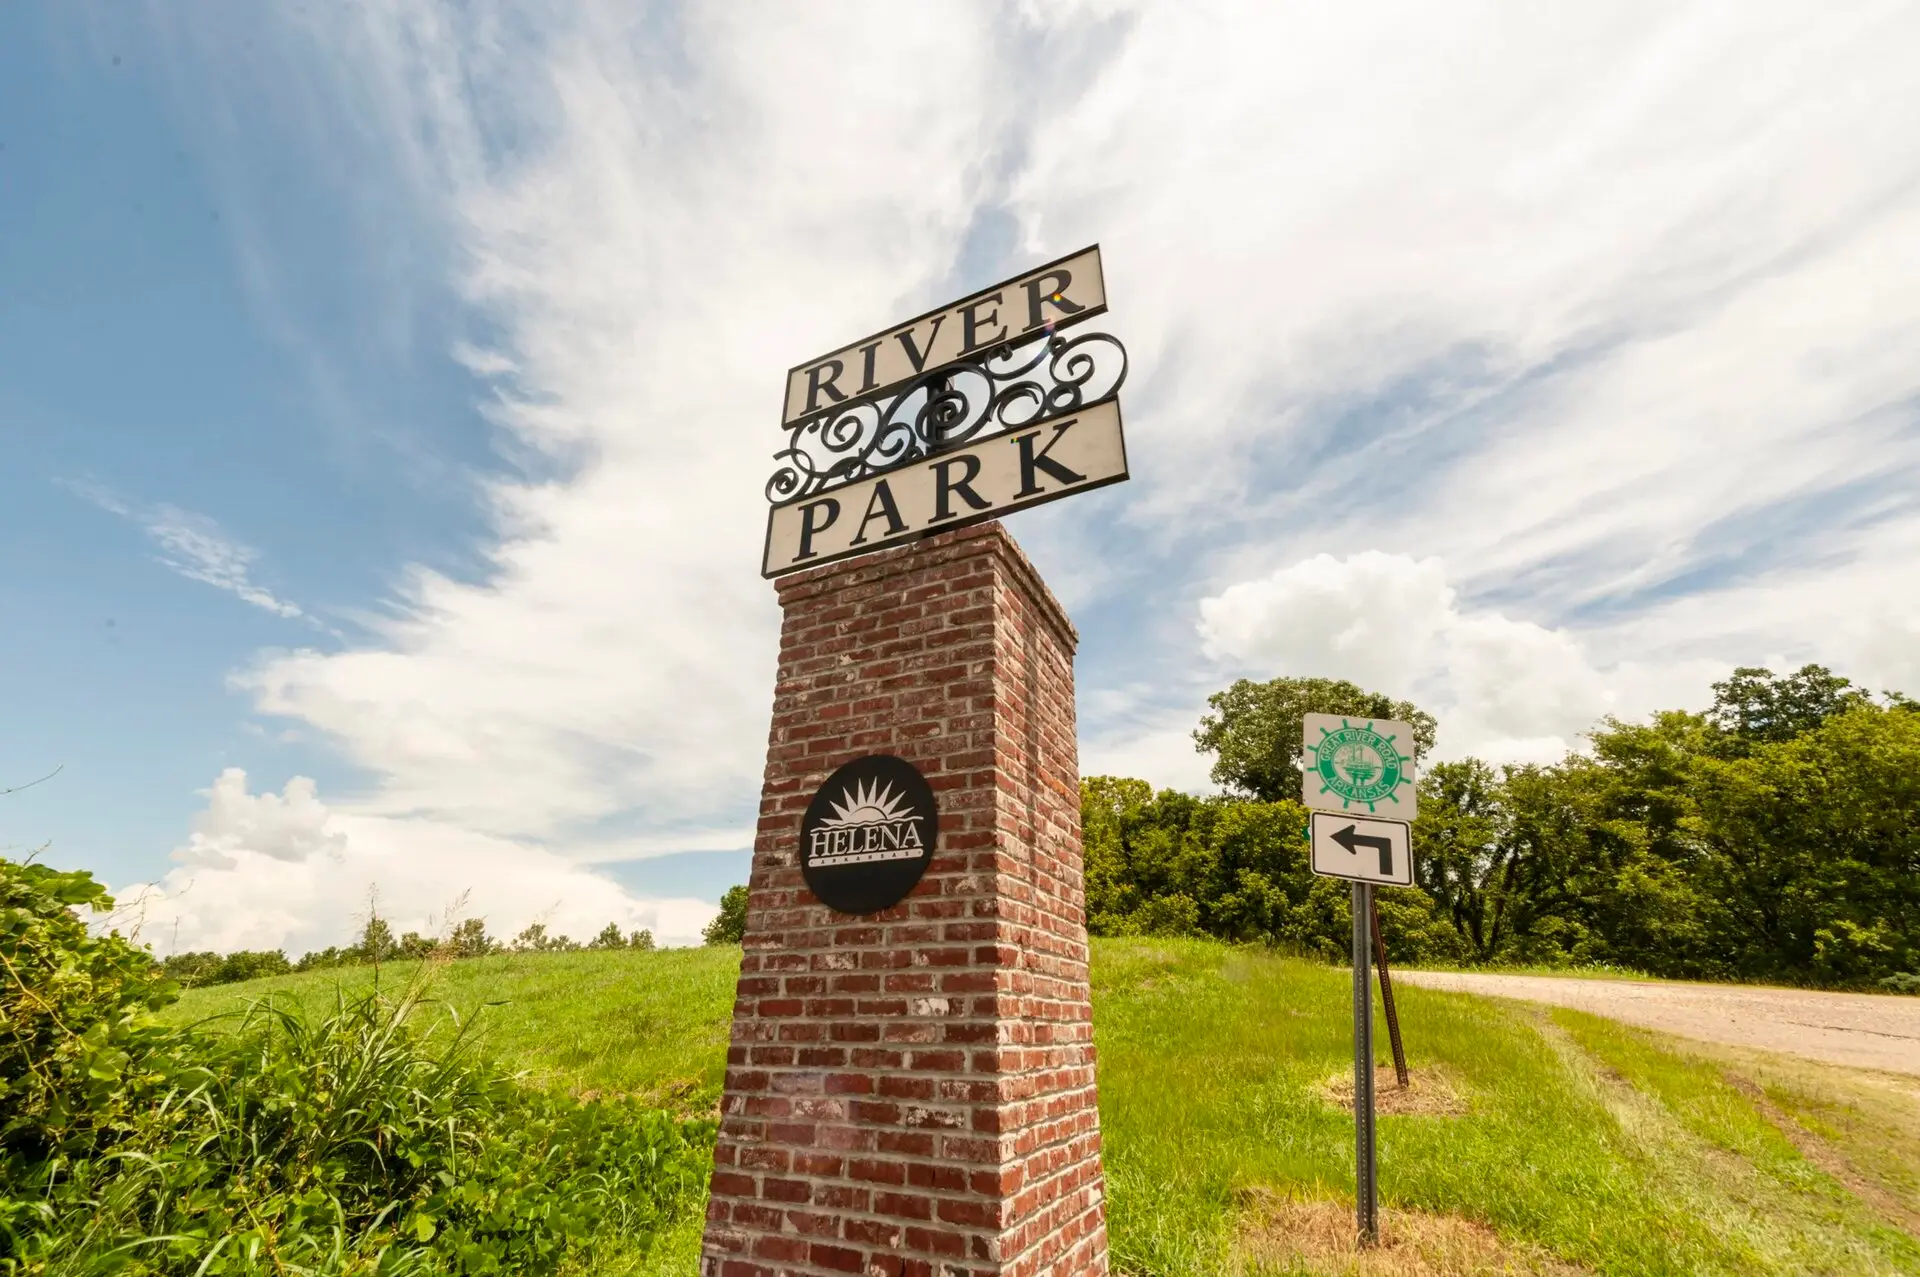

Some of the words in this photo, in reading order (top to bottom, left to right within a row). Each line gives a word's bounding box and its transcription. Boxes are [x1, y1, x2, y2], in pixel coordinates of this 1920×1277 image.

[800, 269, 1085, 416] RIVER
[792, 418, 1087, 562] PARK
[1321, 734, 1342, 761] GREAT
[1345, 731, 1375, 745] RIVER
[1376, 742, 1397, 769] ROAD
[1327, 776, 1389, 798] ARKANSAS
[809, 822, 924, 858] HELENA
